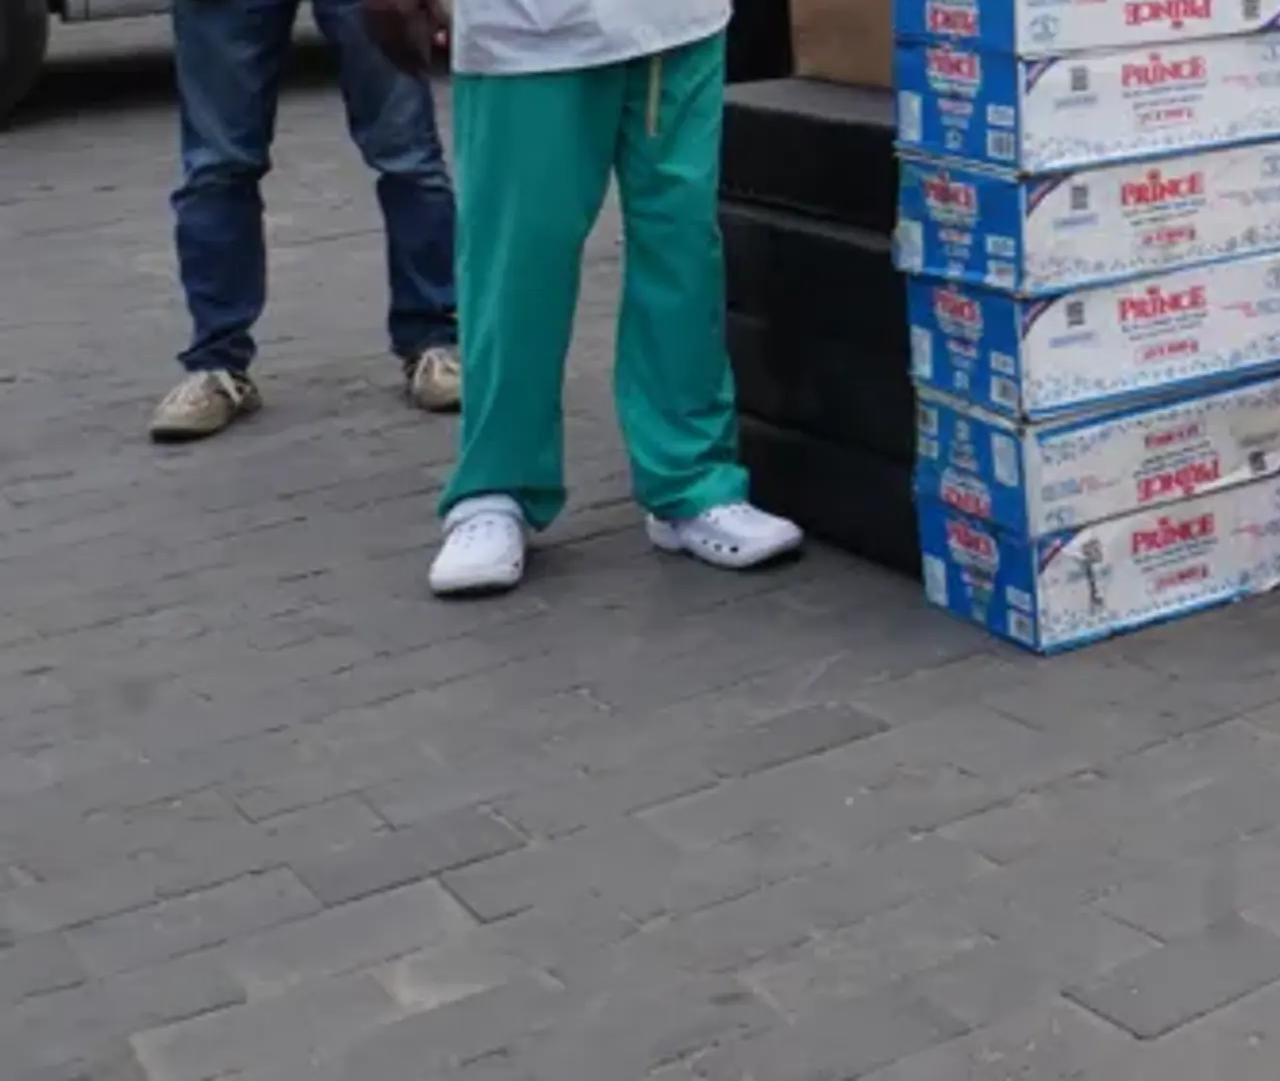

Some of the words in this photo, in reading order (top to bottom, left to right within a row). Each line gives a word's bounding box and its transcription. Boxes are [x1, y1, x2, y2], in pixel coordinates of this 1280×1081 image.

[1121, 53, 1206, 87] PRINCE
[1121, 170, 1204, 207] PRINCE
[1118, 286, 1206, 323] PRINCE
[1137, 455, 1220, 501] PRINCE
[1131, 513, 1215, 555] PRINCE
